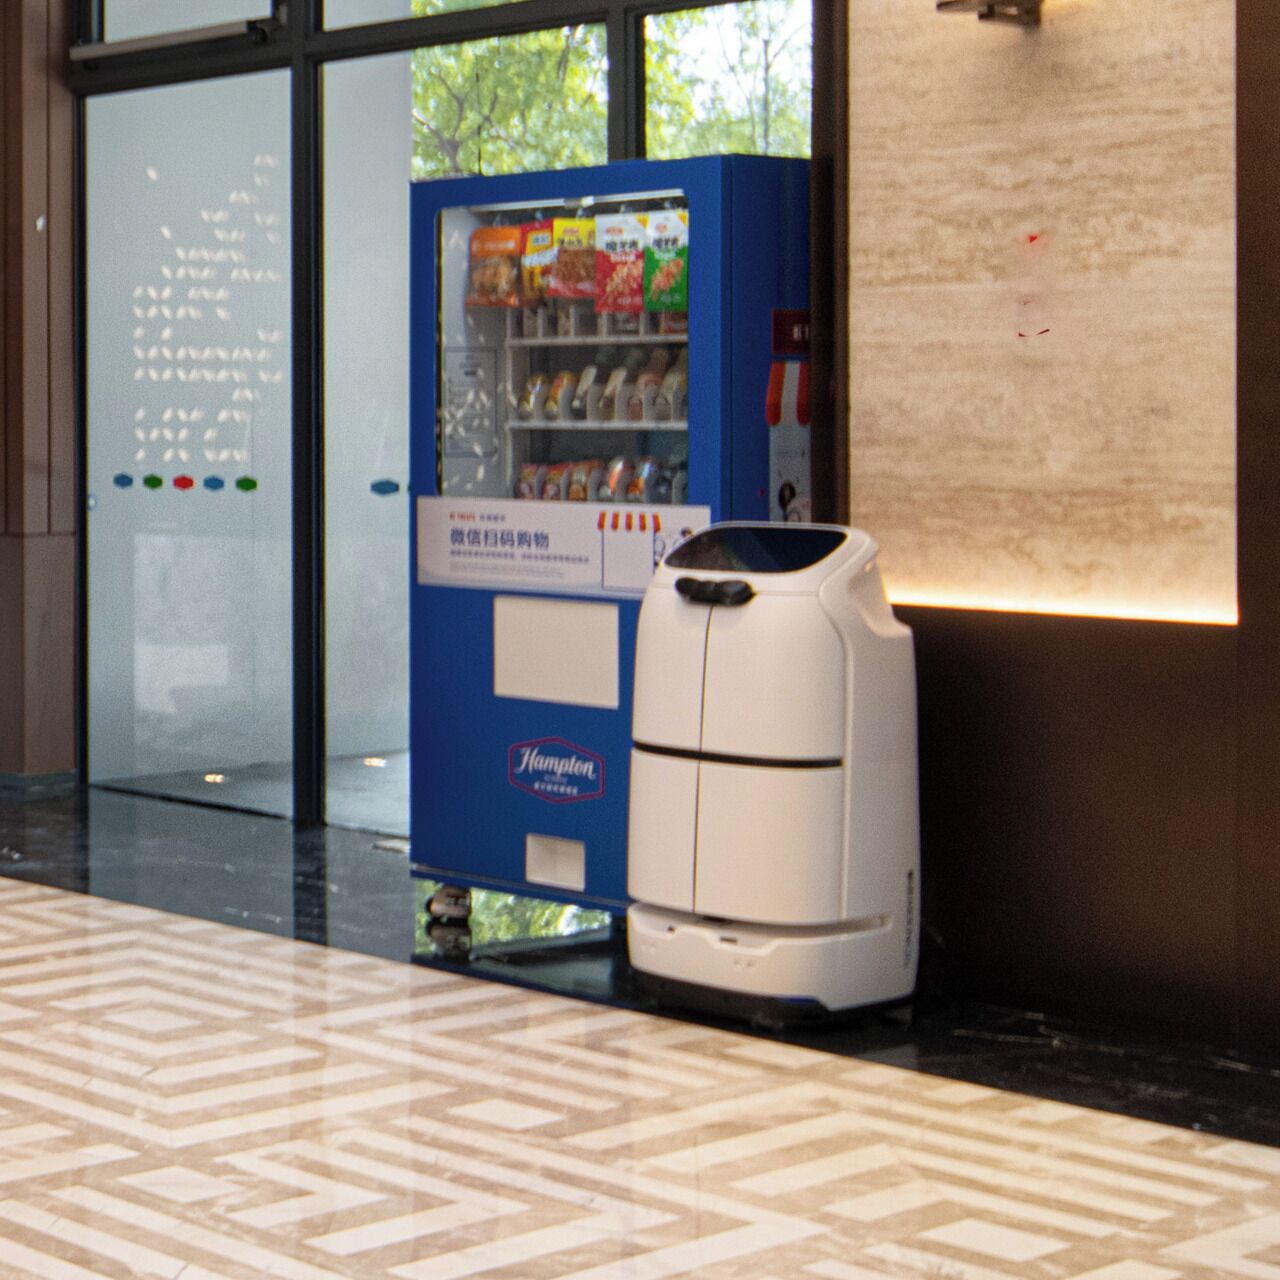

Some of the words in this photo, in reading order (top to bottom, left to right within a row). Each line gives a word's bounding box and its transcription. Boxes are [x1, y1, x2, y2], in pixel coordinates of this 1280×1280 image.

[450, 527, 550, 550] 微信扫码购物
[513, 746, 597, 781] Hampton
